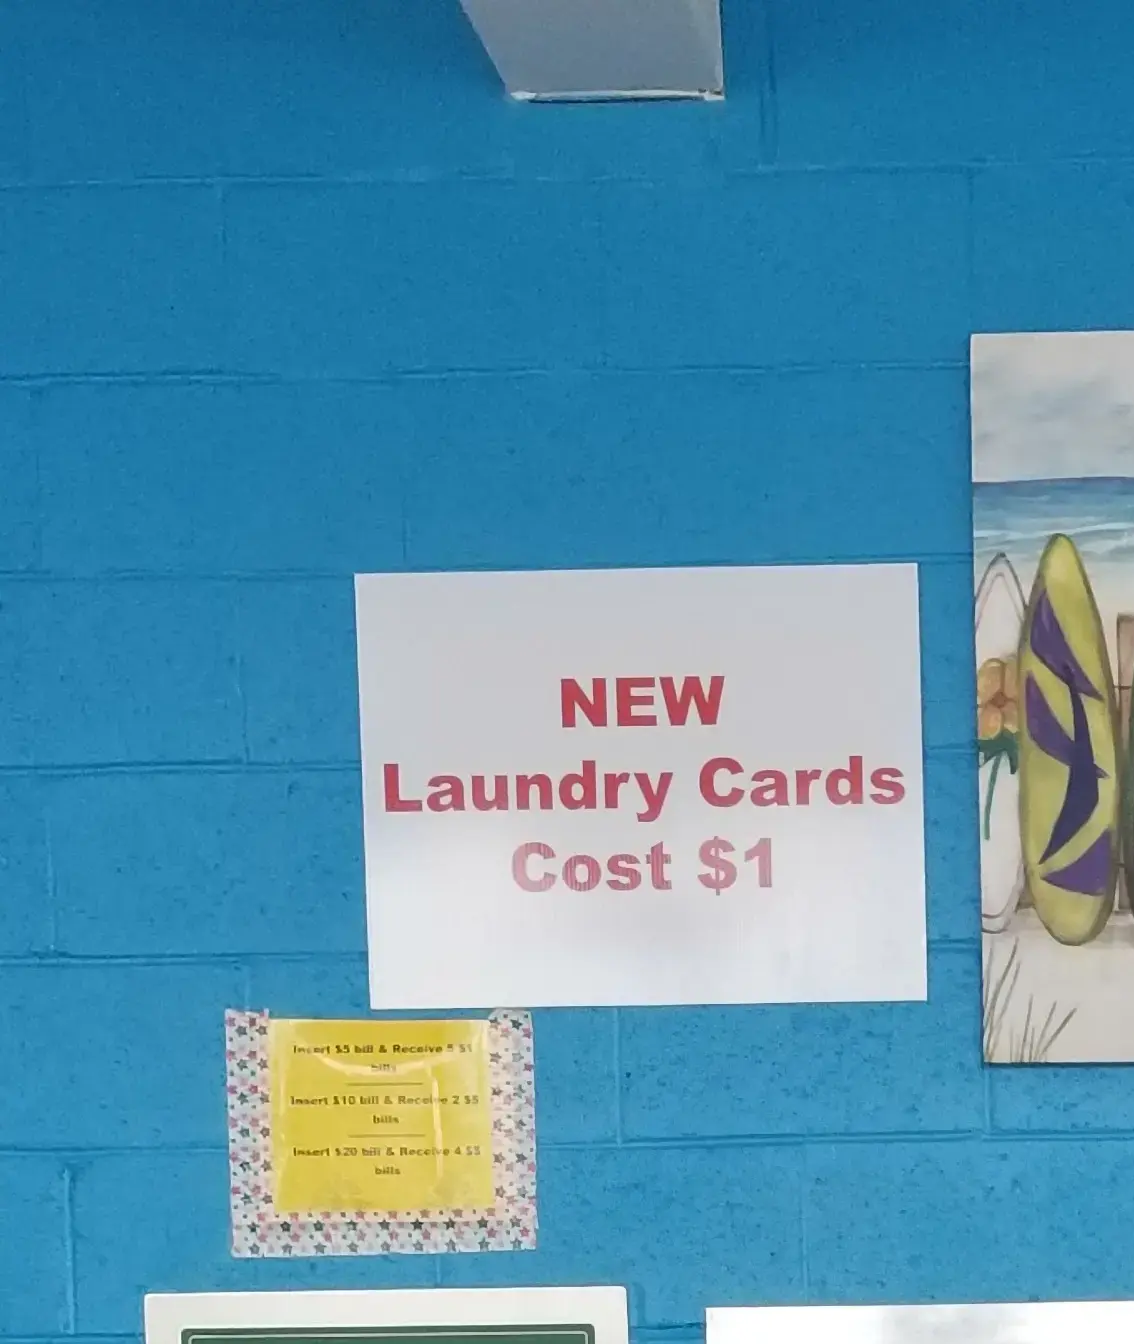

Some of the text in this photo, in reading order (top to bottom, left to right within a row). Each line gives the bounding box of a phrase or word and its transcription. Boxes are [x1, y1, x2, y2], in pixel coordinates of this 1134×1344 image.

[560, 675, 725, 727] NEW
[382, 755, 907, 822] Laundry Cards
[511, 836, 773, 896] Cost $1
[293, 1044, 330, 1054] Insert
[335, 1044, 350, 1054] $5
[354, 1044, 374, 1053] bill
[378, 1045, 388, 1053] &
[392, 1044, 443, 1053] Receive
[291, 1095, 479, 1105] Insert $10 bill & Receive 2 $5
[372, 1115, 400, 1124] bills
[293, 1146, 481, 1156] Insert $20 bill & Receive 4 $5
[374, 1166, 401, 1175] bills
